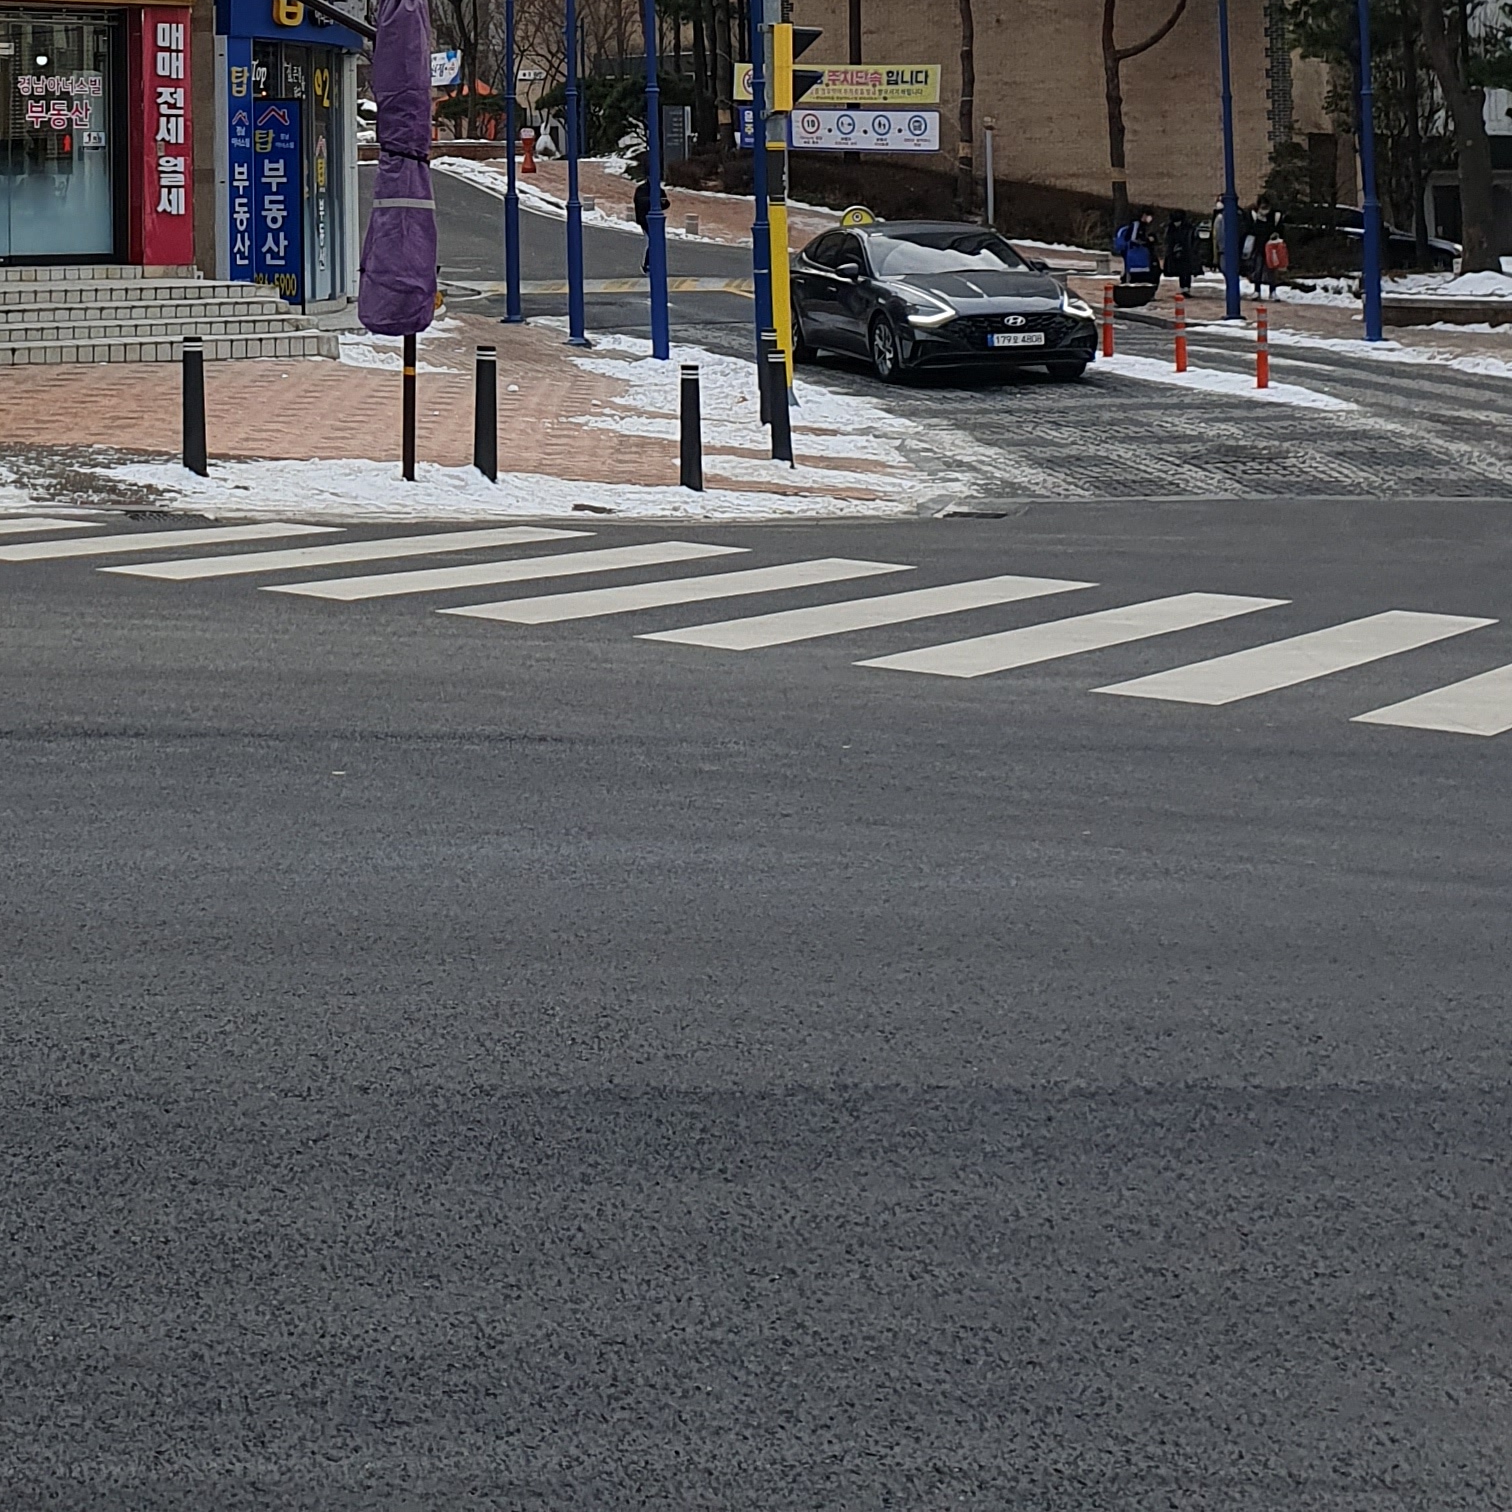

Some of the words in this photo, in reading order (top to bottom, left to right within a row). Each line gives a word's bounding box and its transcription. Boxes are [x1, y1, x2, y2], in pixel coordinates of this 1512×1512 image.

[156, 23, 184, 80] 매매
[17, 75, 103, 96] 경남아너스빌
[231, 66, 250, 98] 탑
[886, 70, 929, 86] 입니다
[25, 100, 92, 129] 부동산
[156, 87, 185, 144] 전세
[255, 129, 275, 153] 탑
[157, 156, 186, 216] 월세
[232, 162, 251, 266] 부동산
[260, 158, 289, 266] 부동산
